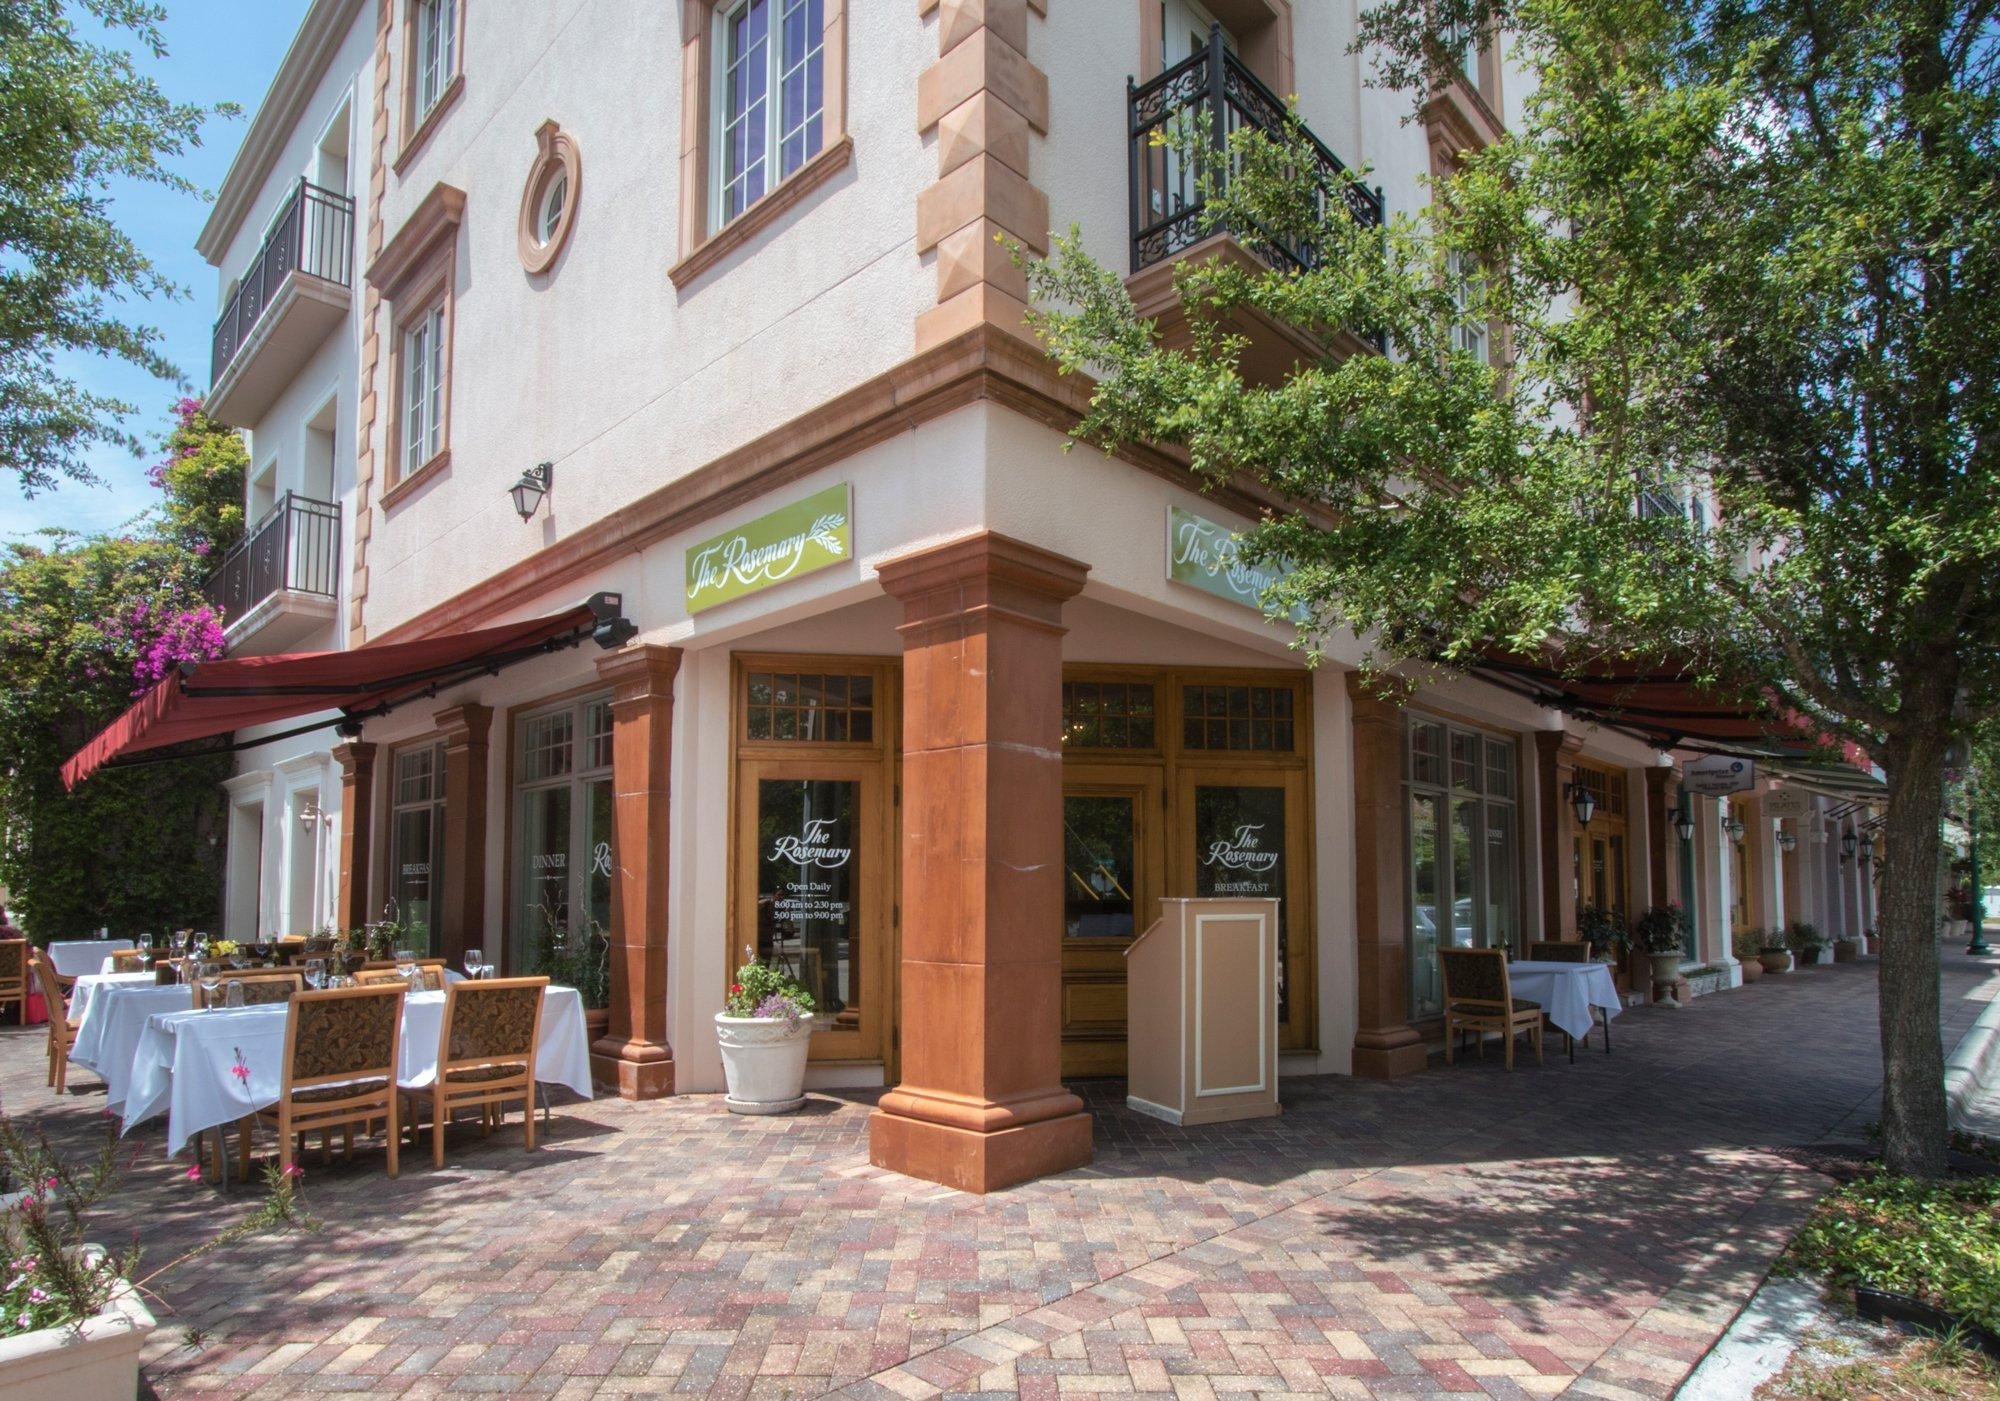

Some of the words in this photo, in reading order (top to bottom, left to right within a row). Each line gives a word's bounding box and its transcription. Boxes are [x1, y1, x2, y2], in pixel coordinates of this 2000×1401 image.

[1174, 523, 1215, 564] The
[687, 540, 724, 598] The
[716, 535, 806, 589] Rosemary
[799, 818, 837, 845] The
[1230, 824, 1265, 849] The
[533, 853, 566, 869] DINNER
[767, 835, 851, 868] Rosemary
[1202, 840, 1278, 872] Rosemary
[786, 882, 809, 892] Open
[810, 882, 831, 892] Daily
[1214, 883, 1269, 892] BREAKFAST
[790, 913, 803, 921] pm
[805, 911, 814, 919] to
[830, 913, 844, 921] pm
[804, 901, 813, 909] to
[830, 902, 843, 911] pm
